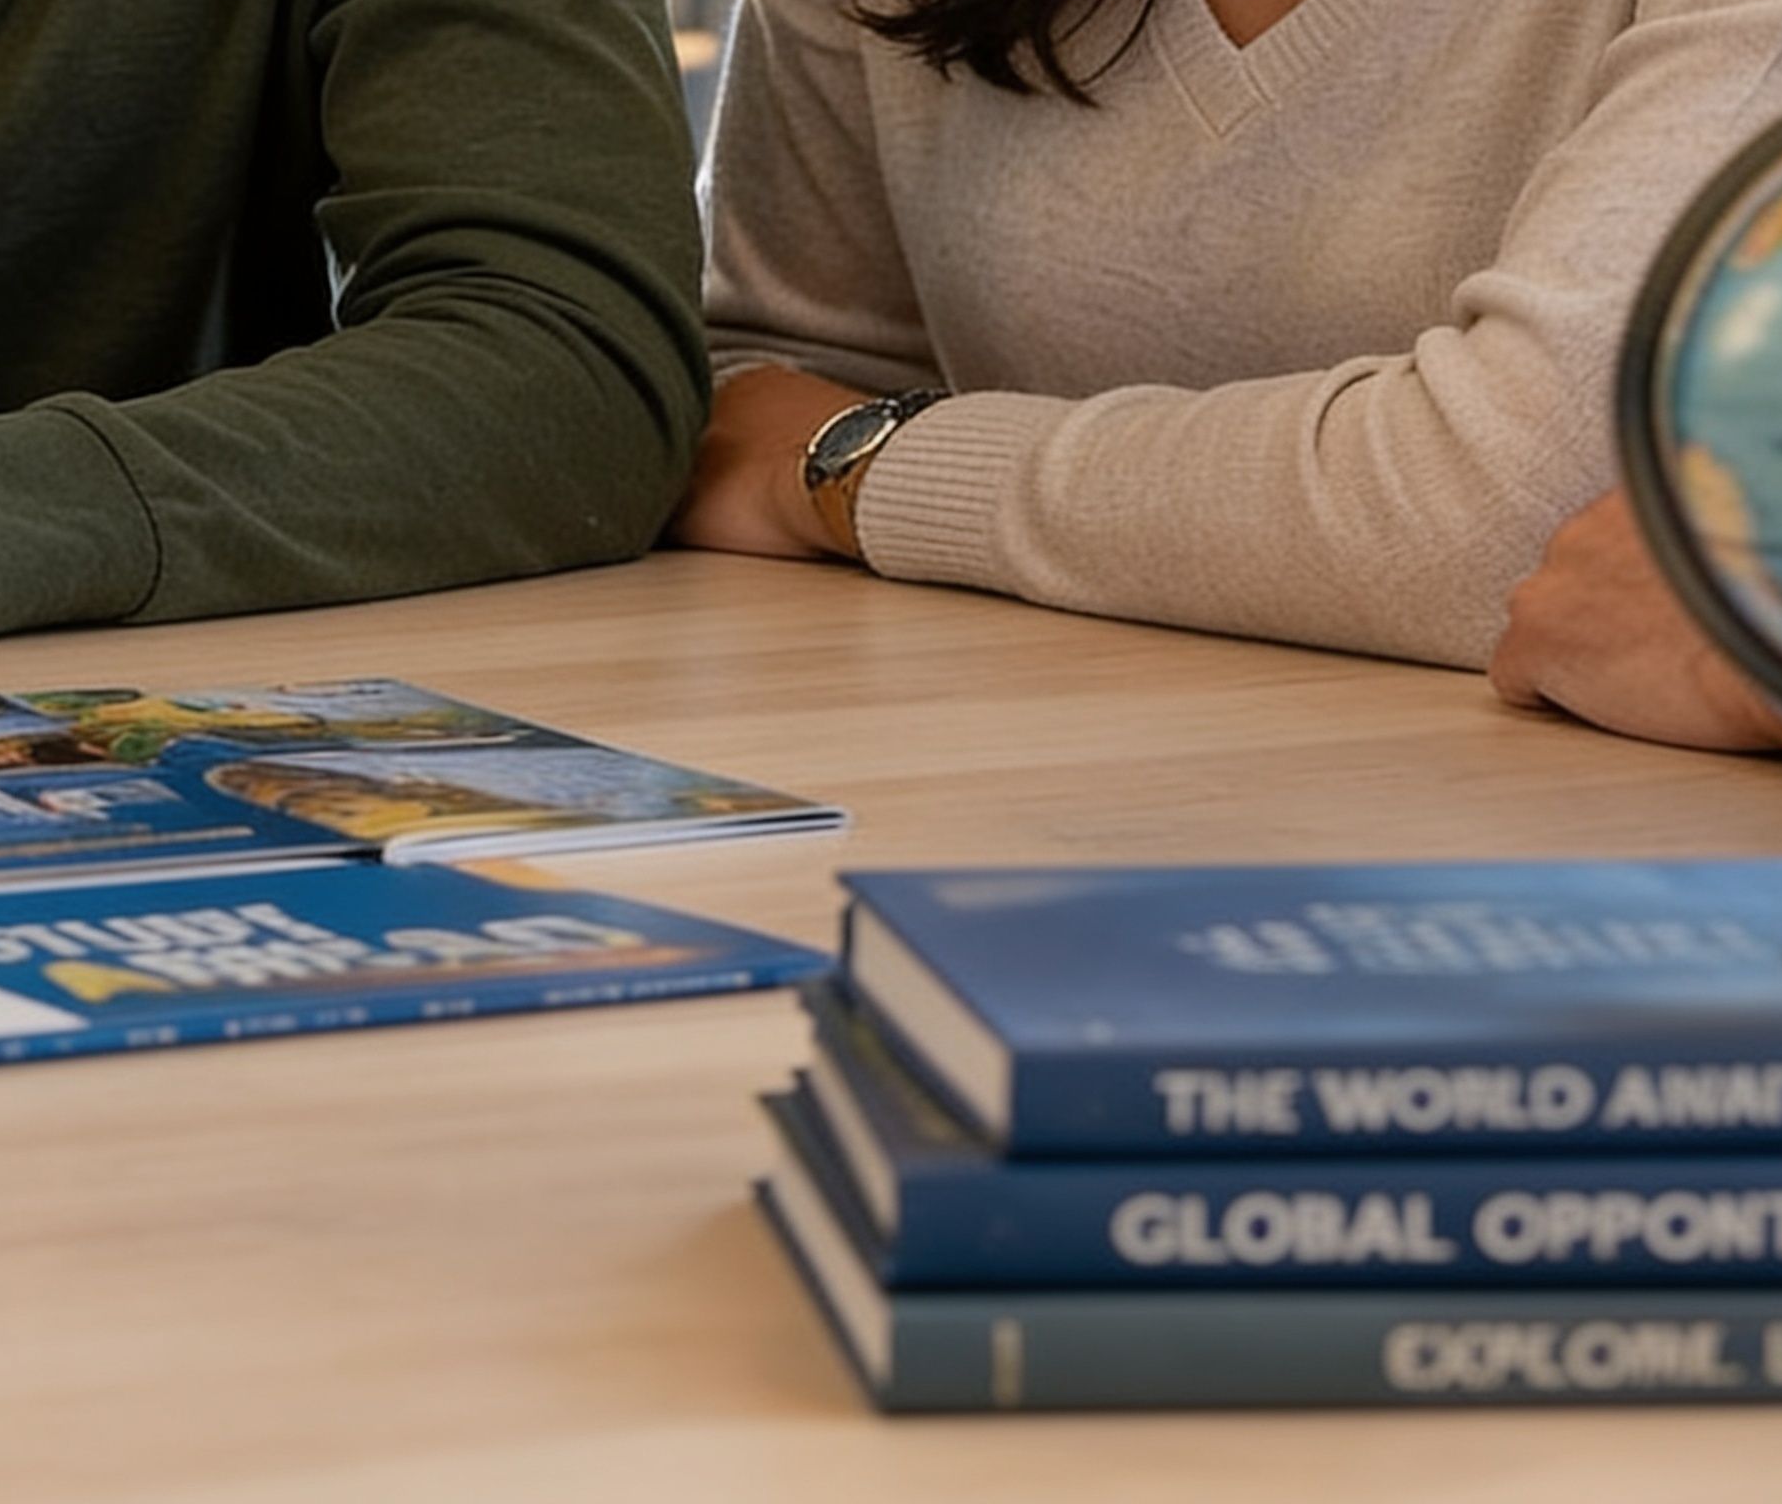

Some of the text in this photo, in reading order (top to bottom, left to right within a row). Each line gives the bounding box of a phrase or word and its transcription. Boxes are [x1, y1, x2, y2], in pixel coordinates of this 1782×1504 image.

[1153, 1067, 1302, 1136] THE
[1317, 1063, 1597, 1133] WORLD
[1110, 1191, 1457, 1266] GLOBAL
